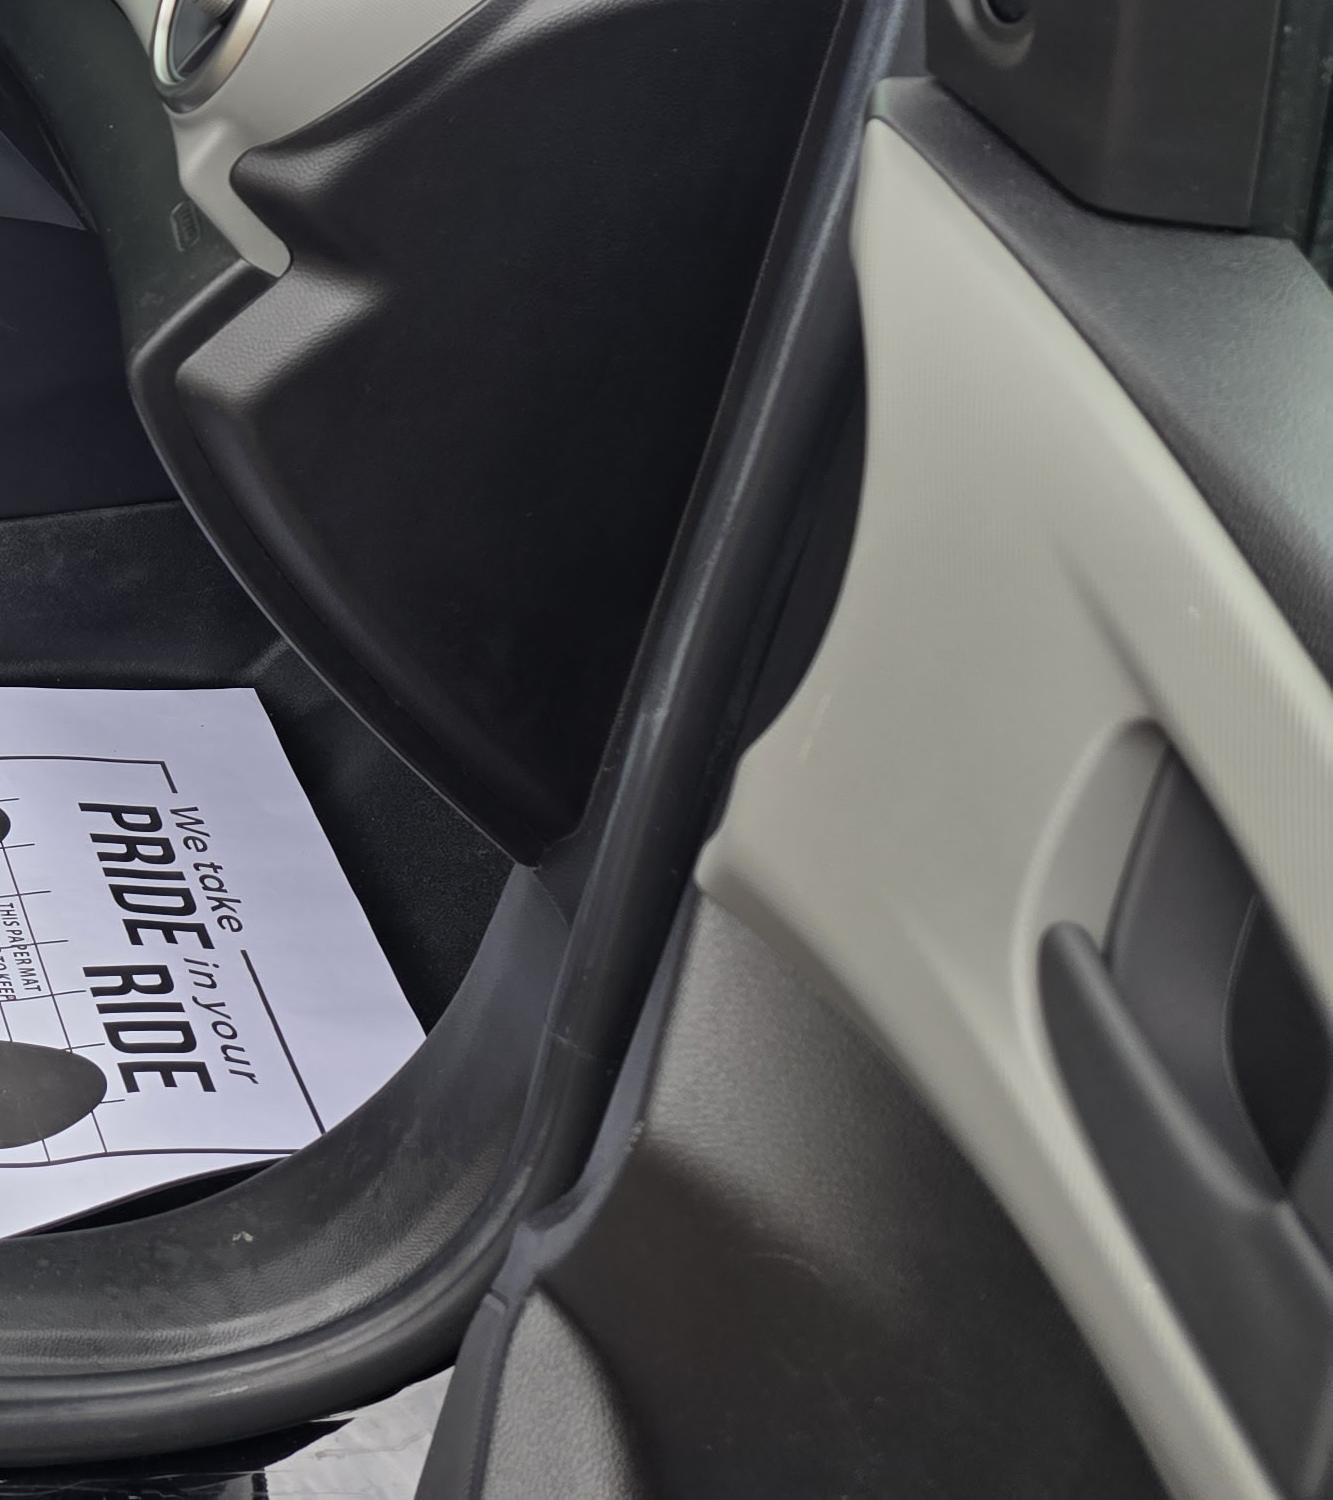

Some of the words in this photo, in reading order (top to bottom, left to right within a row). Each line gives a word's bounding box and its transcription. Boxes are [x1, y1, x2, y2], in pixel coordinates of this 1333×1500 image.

[78, 802, 215, 950] PRIDE
[169, 806, 211, 853] We
[192, 861, 244, 934] take
[5, 929, 32, 965] PAPER
[18, 967, 42, 992] MAT
[183, 957, 220, 990] in
[82, 964, 217, 1094] RIDE
[191, 995, 260, 1085] your
